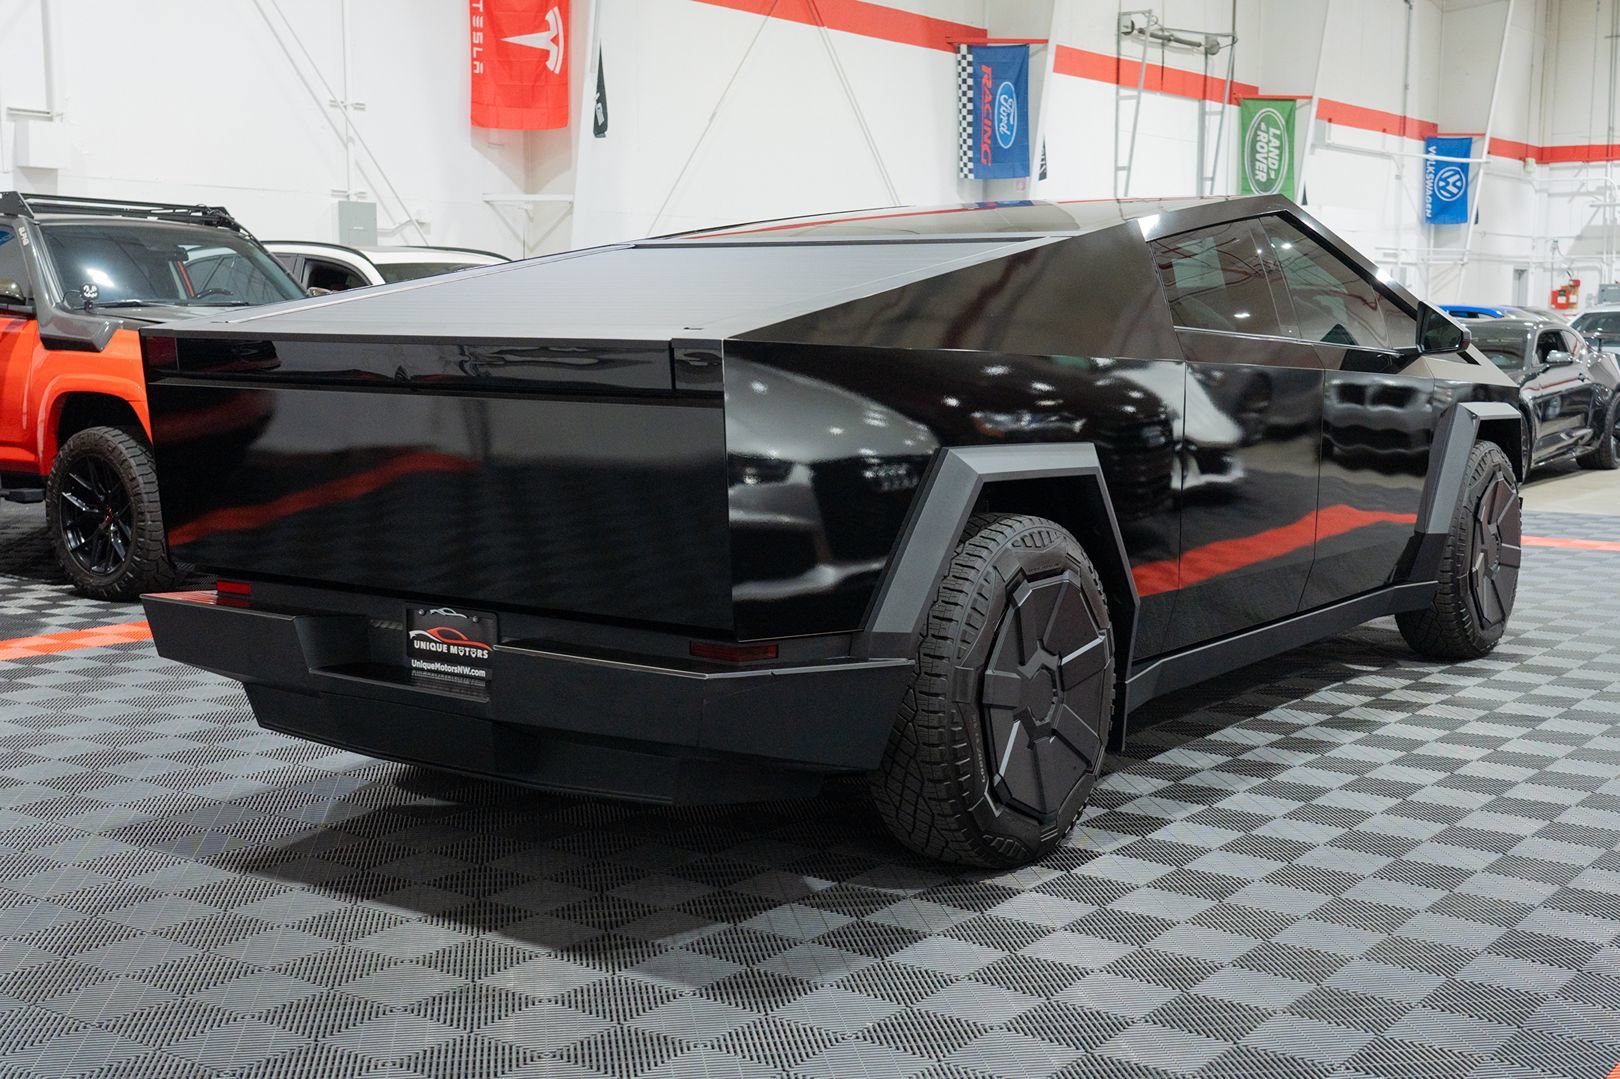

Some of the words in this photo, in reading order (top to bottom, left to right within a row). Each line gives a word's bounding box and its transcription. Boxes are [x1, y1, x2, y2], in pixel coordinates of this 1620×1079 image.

[471, 0, 484, 74] TESLA
[981, 64, 993, 168] RACING
[999, 94, 1016, 136] Ford
[1255, 130, 1269, 182] ROVER
[1268, 127, 1281, 171] LAND
[411, 659, 486, 678] UniqueMotorsNW.com
[413, 640, 448, 653] UNIQUE
[449, 645, 489, 659] MOTORS
